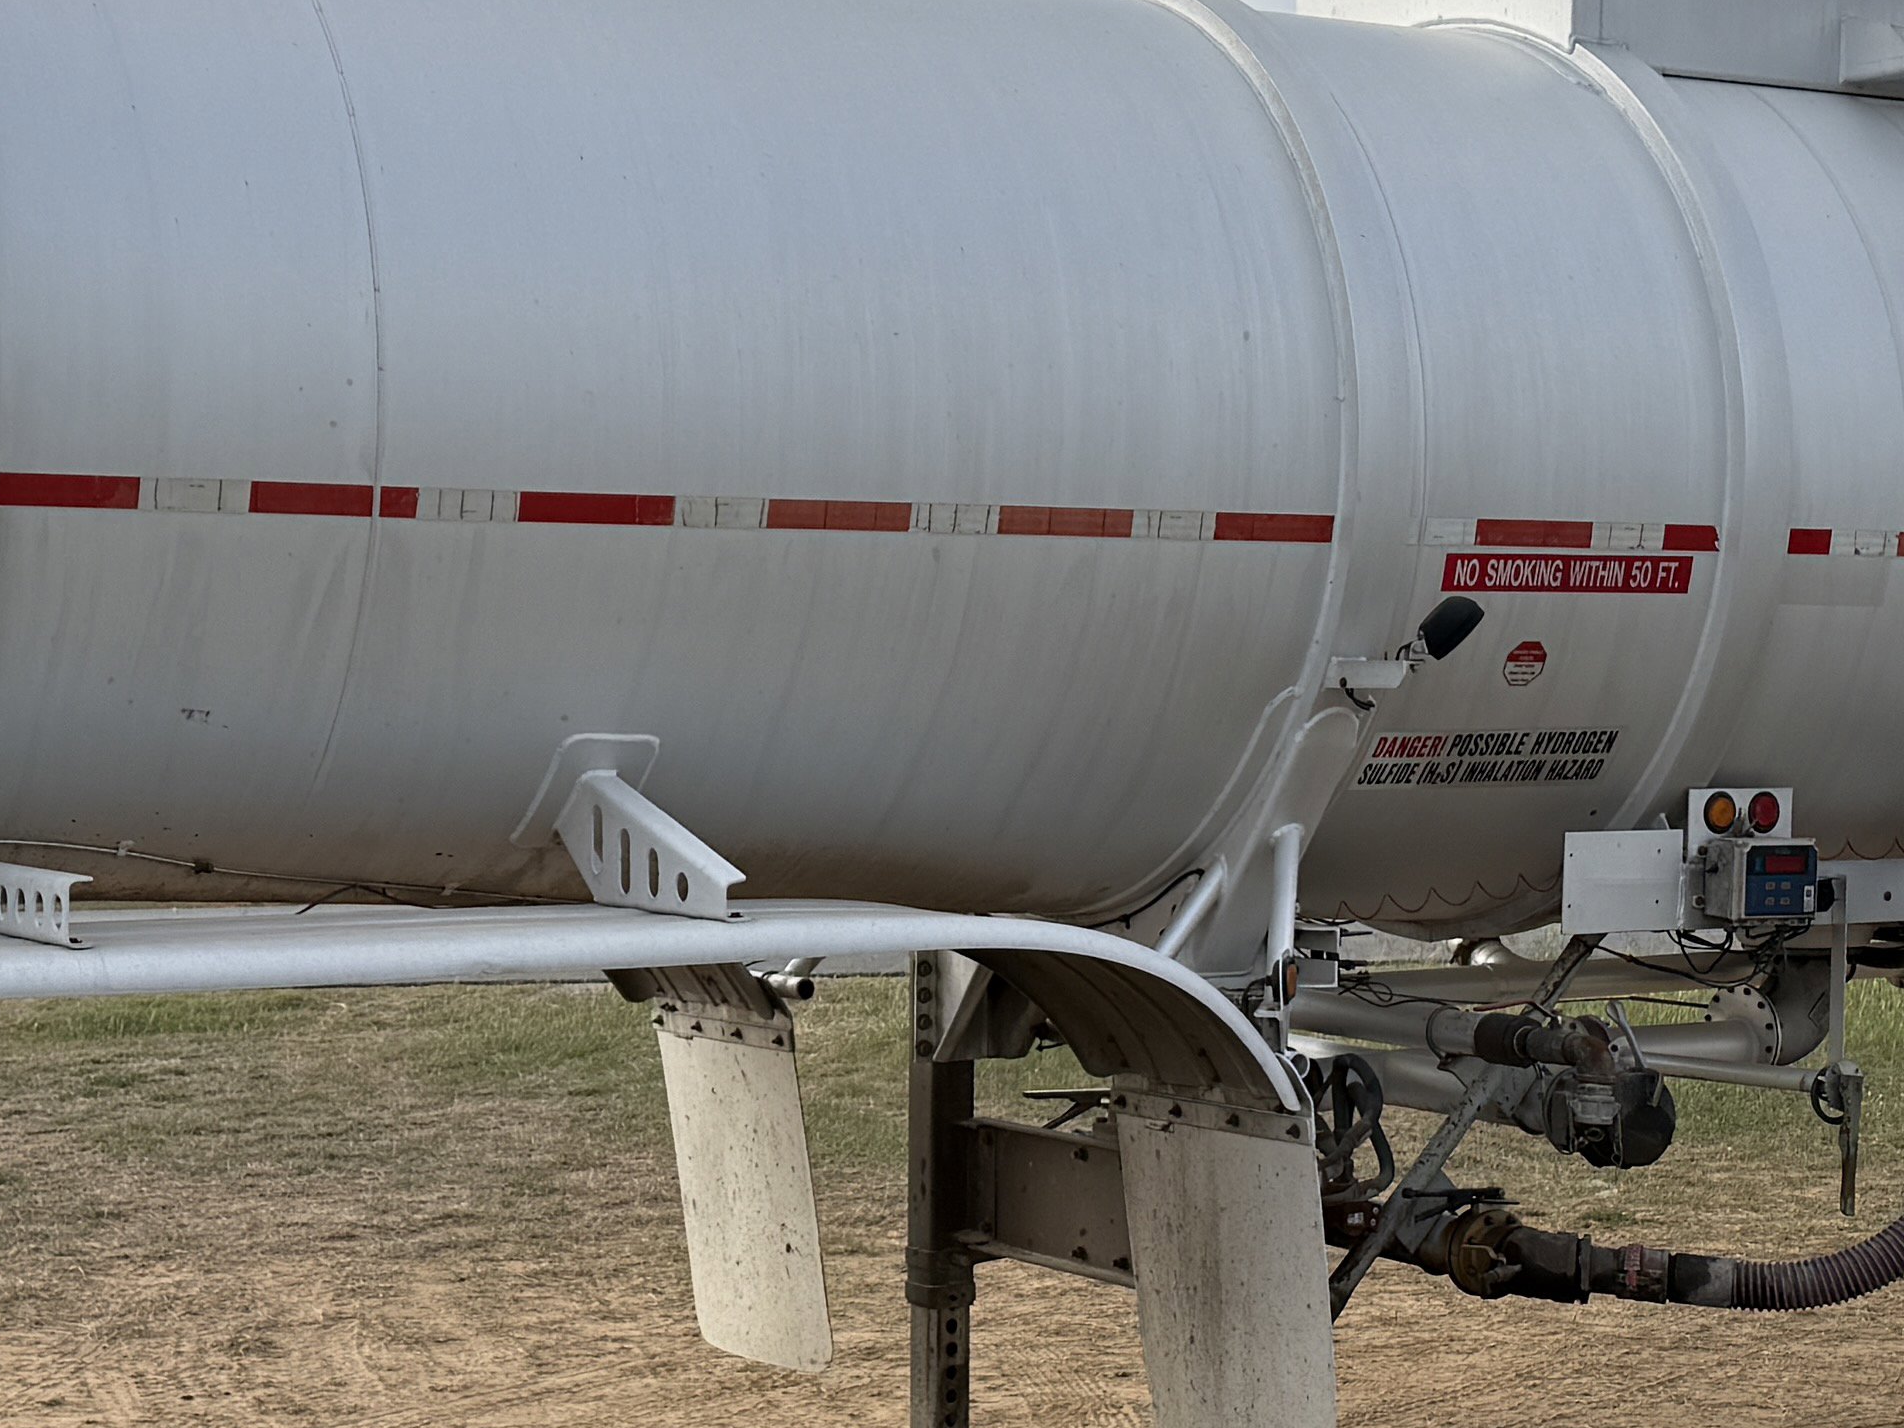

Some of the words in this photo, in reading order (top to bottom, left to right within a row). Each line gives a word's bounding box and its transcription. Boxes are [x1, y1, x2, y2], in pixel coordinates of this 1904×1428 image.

[1453, 559, 1480, 586] NO
[1485, 559, 1564, 587] SMOKING
[1569, 560, 1625, 588] WITHIN
[1629, 561, 1652, 588] 50
[1656, 561, 1680, 589] FT.
[1372, 735, 1449, 759] DANGER!
[1446, 732, 1530, 757] POSSIBLE
[1529, 730, 1619, 755] HYDROGEN
[1357, 763, 1421, 785] SULFIDE
[1458, 759, 1548, 783] INHALATION
[1543, 758, 1605, 781] HAZARD
